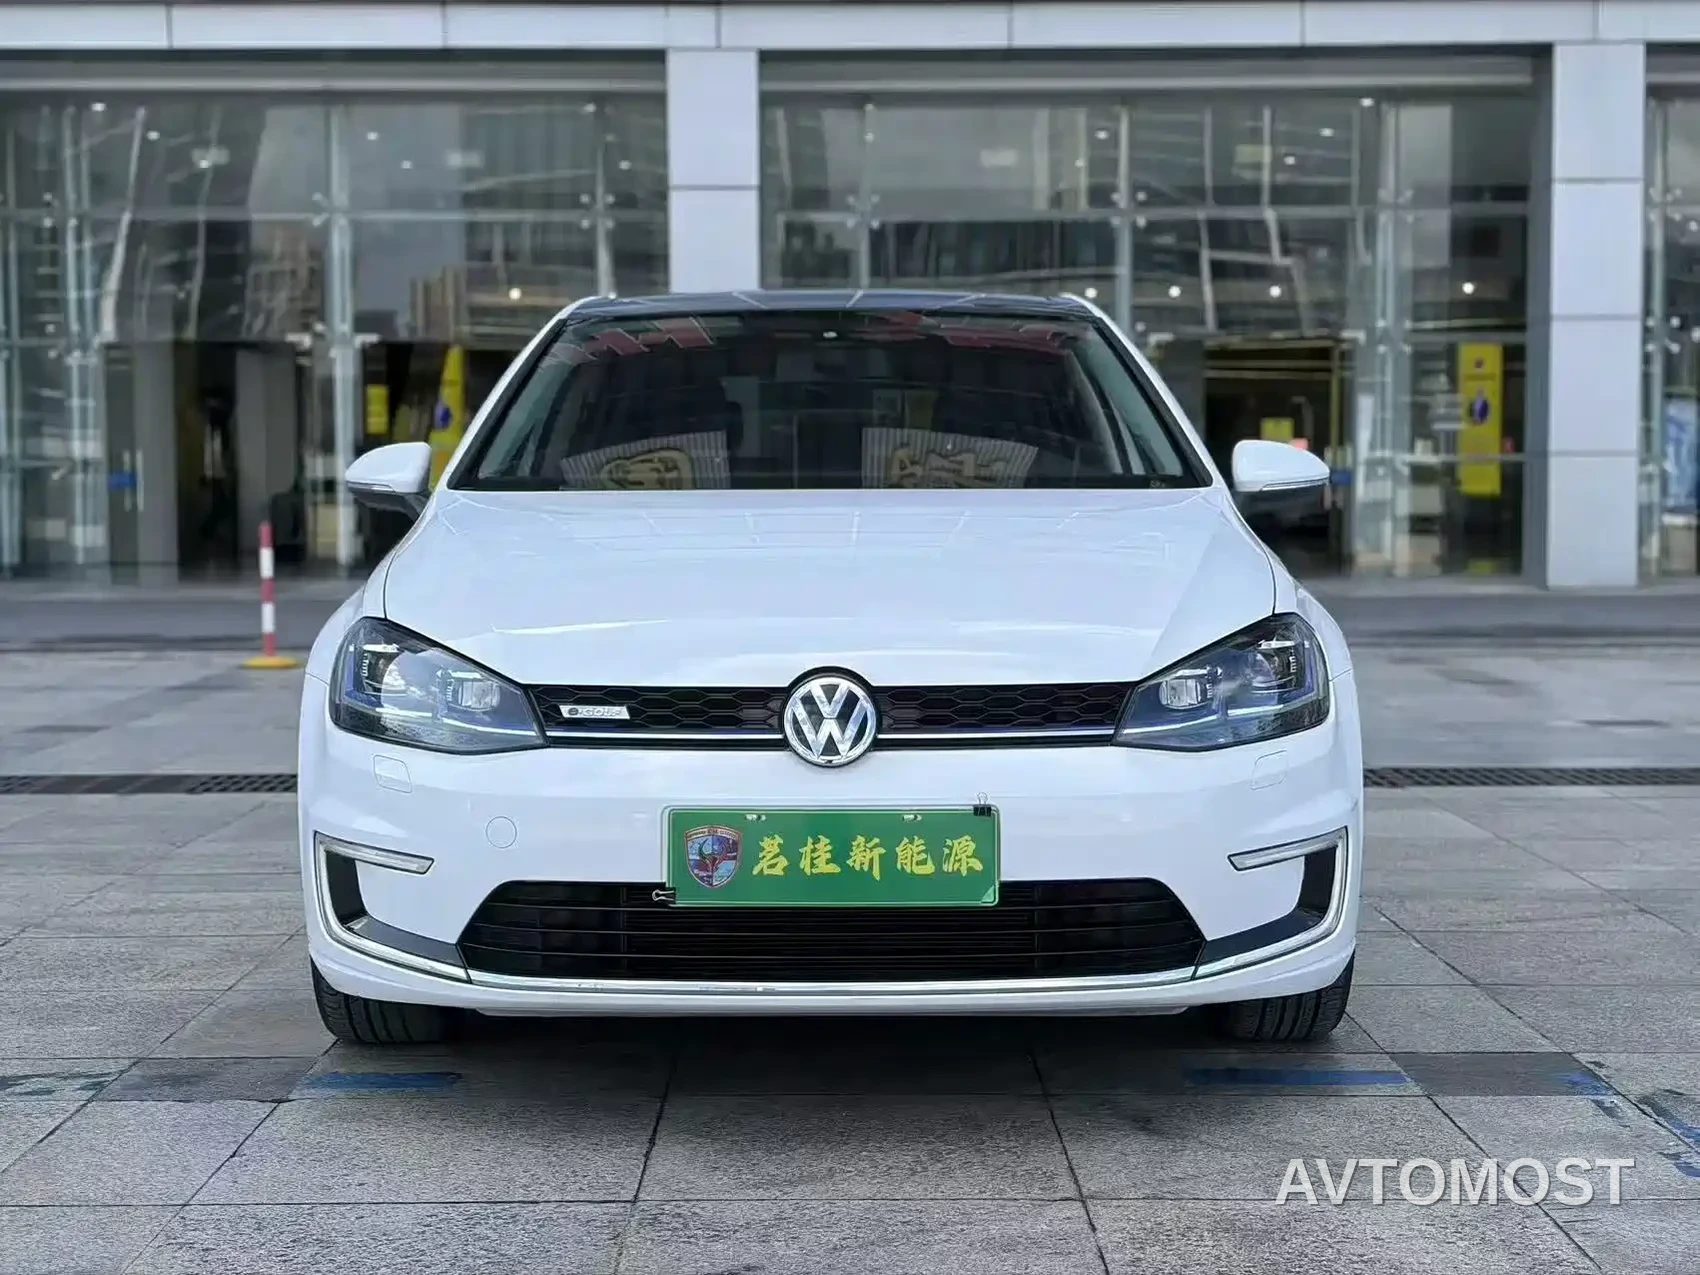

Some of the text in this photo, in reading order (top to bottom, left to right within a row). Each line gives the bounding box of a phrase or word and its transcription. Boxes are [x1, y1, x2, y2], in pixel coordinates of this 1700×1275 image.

[752, 833, 984, 881] 茗桂新能源
